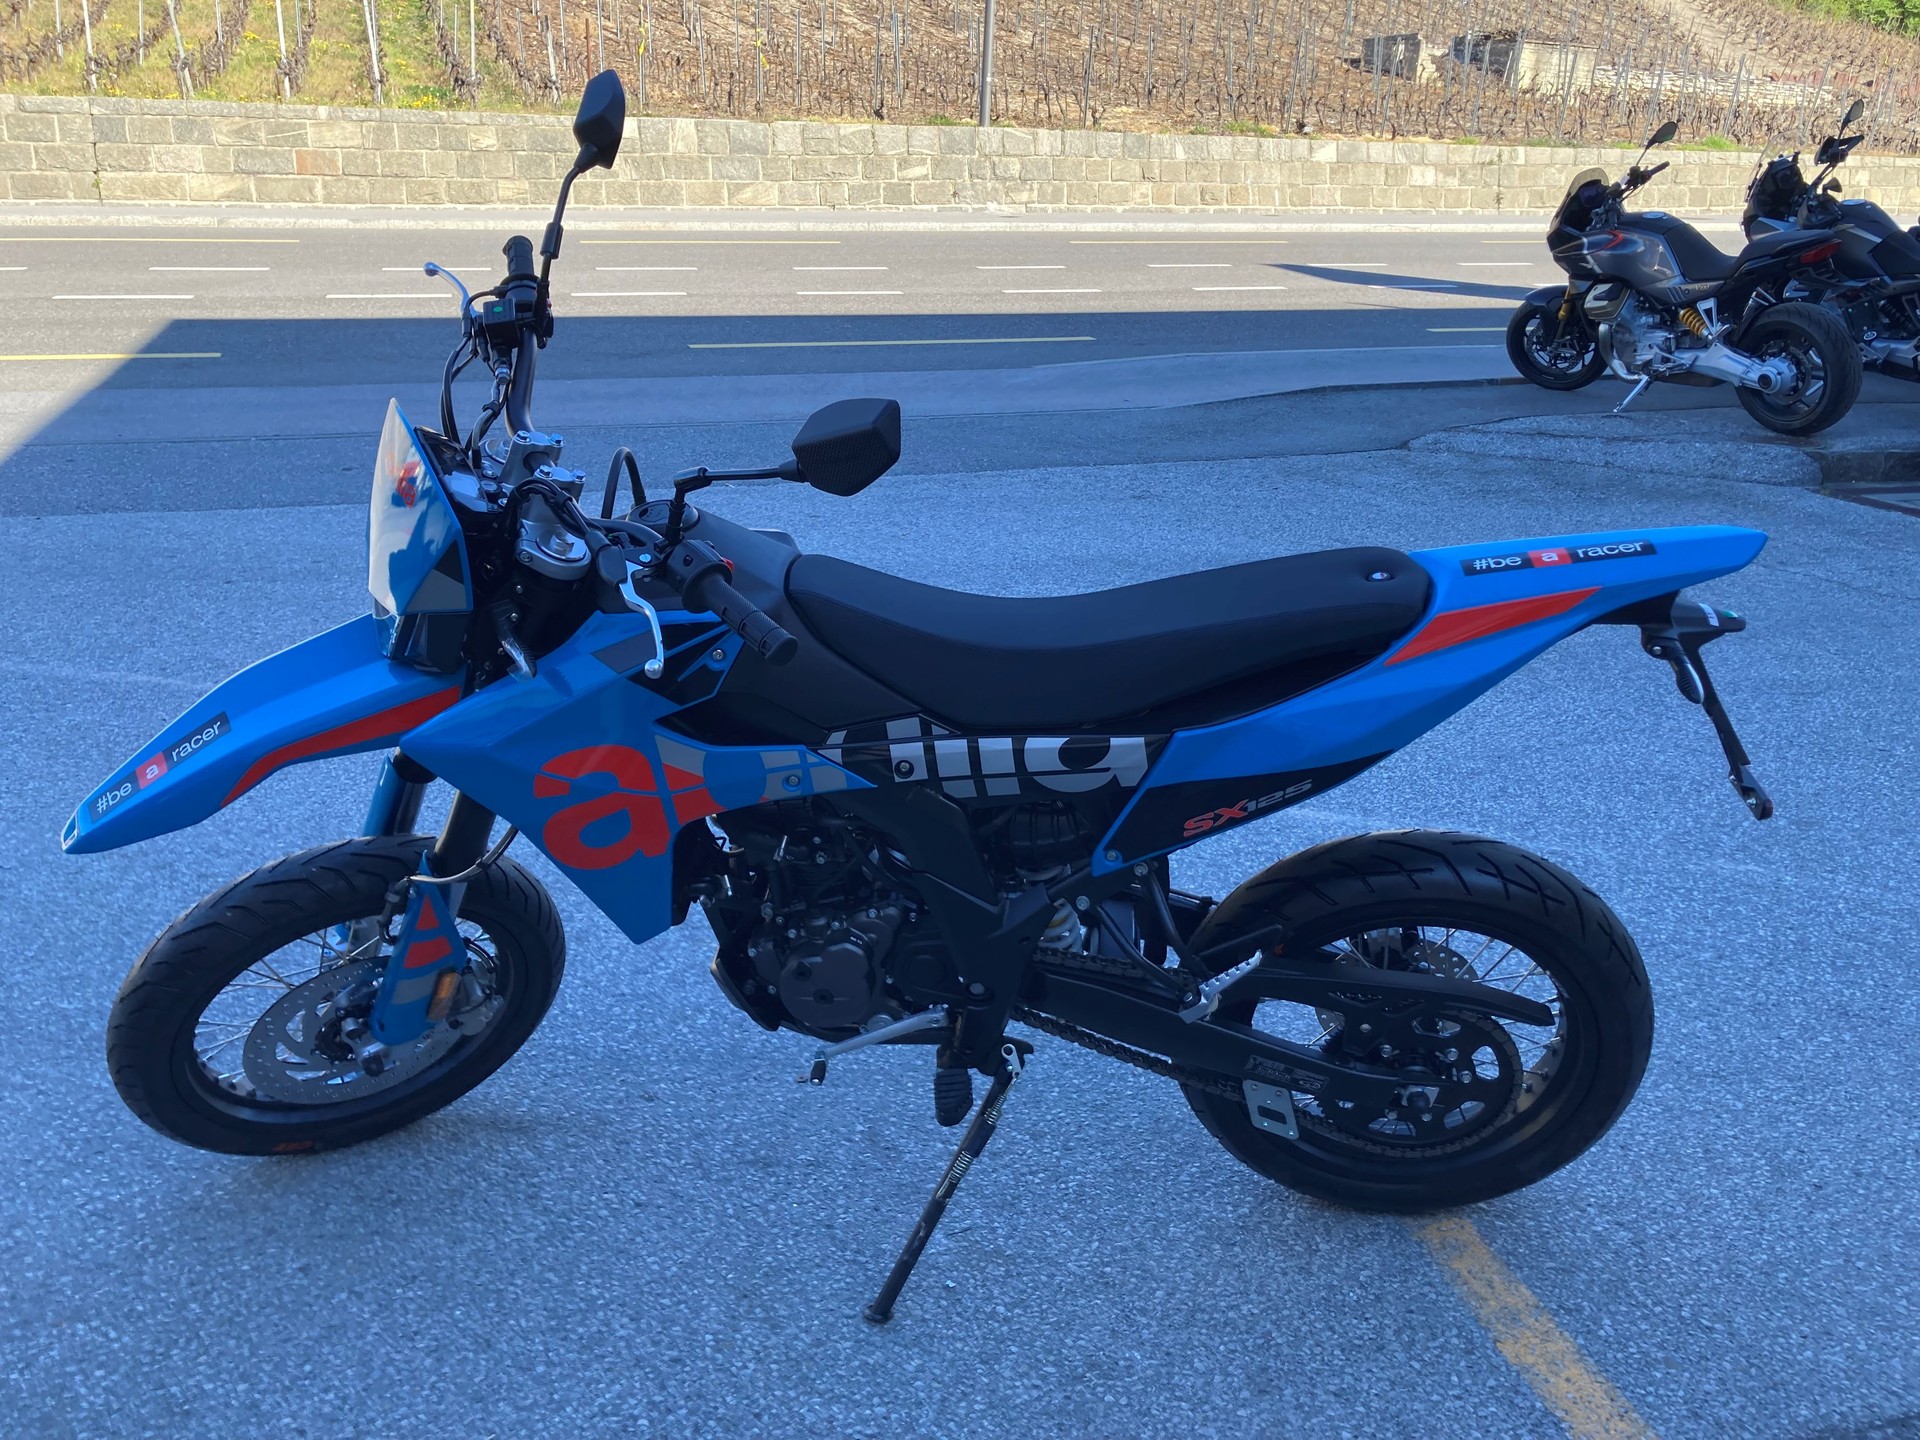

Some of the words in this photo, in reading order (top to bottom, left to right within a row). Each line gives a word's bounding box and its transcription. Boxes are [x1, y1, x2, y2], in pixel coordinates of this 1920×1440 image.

[1473, 556, 1522, 570] #be
[1541, 551, 1559, 562] a
[1576, 541, 1644, 558] racer
[96, 782, 132, 813] #be
[145, 763, 159, 779] a
[171, 721, 221, 761] racer
